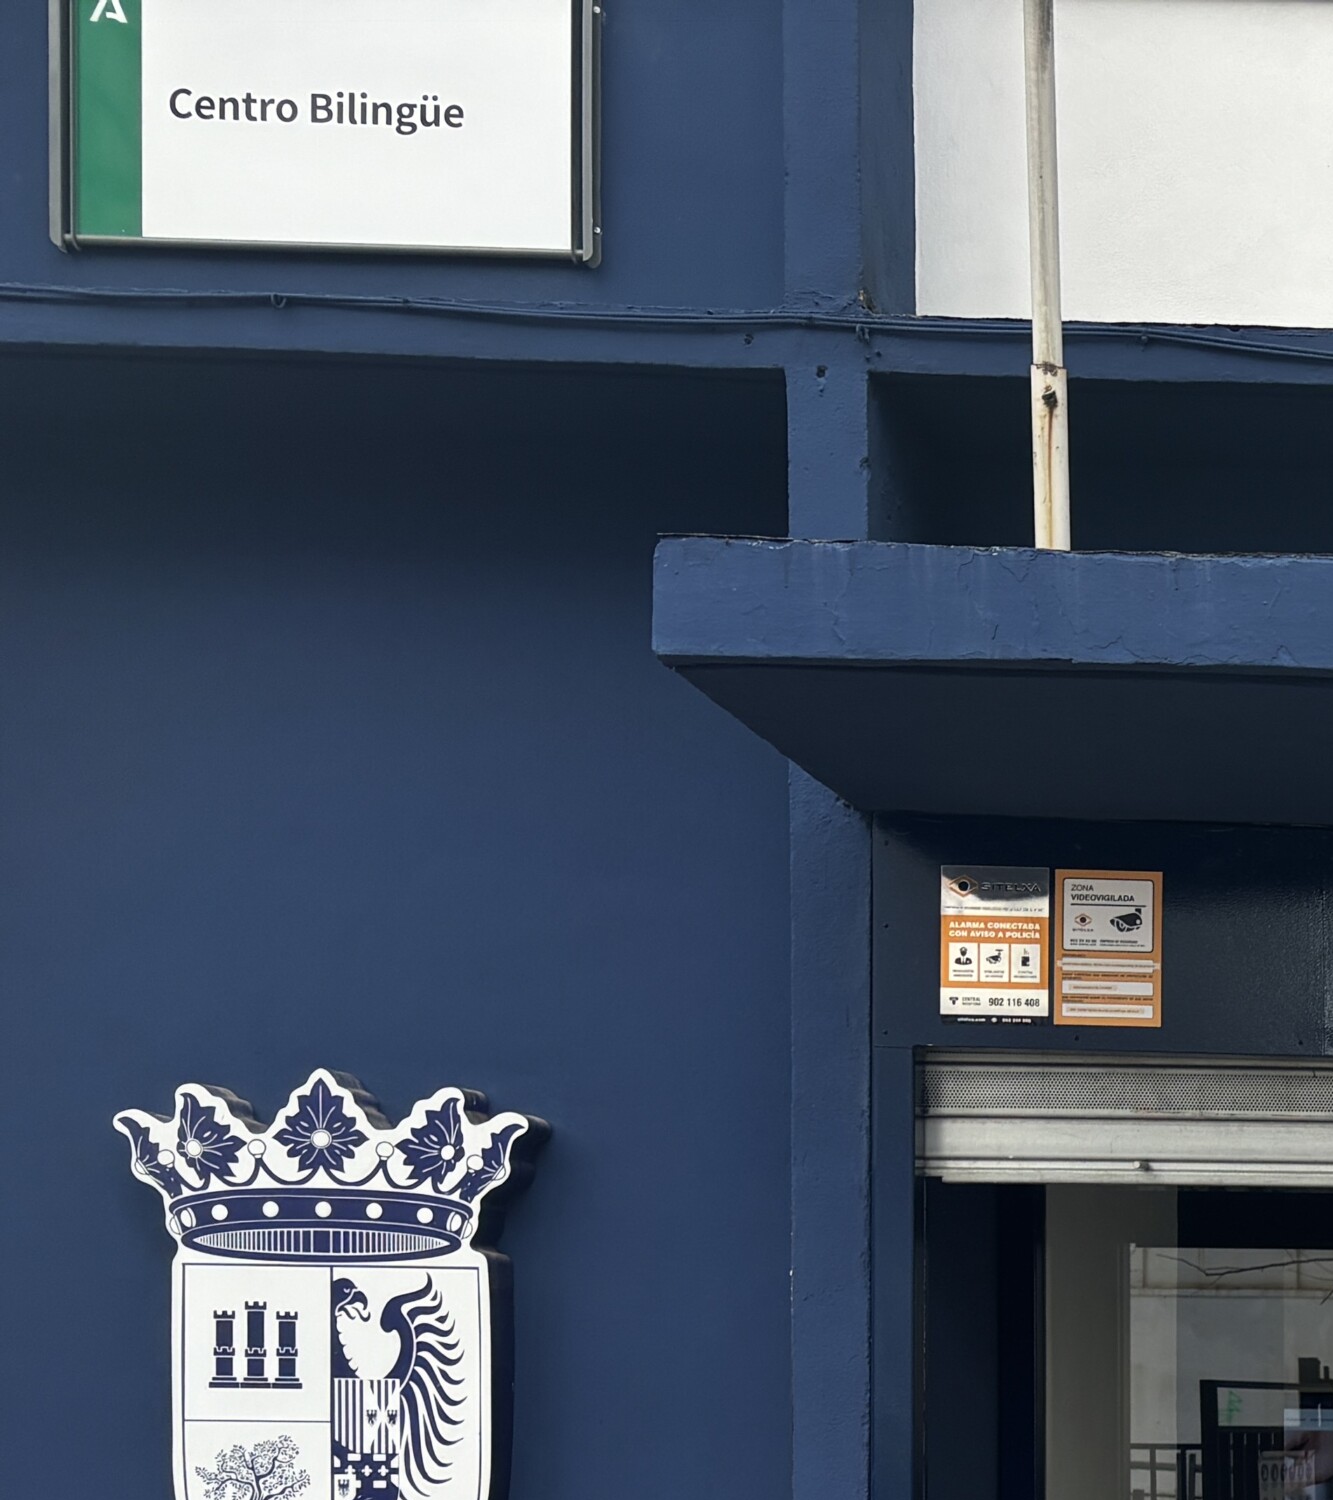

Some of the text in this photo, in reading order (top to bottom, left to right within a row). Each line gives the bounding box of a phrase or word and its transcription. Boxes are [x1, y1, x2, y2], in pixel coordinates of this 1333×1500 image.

[168, 87, 465, 136] Centro Bilingüe
[1070, 883, 1094, 892] ZONA
[1070, 893, 1135, 903] VIDEOVIGILADA
[949, 921, 1041, 930] ALARMA CONECTADA
[970, 930, 996, 938] AVISO
[1005, 931, 1041, 939] POLICÍA
[988, 997, 1004, 1006] 902
[1007, 998, 1022, 1007] 116
[1024, 998, 1040, 1007] 408
